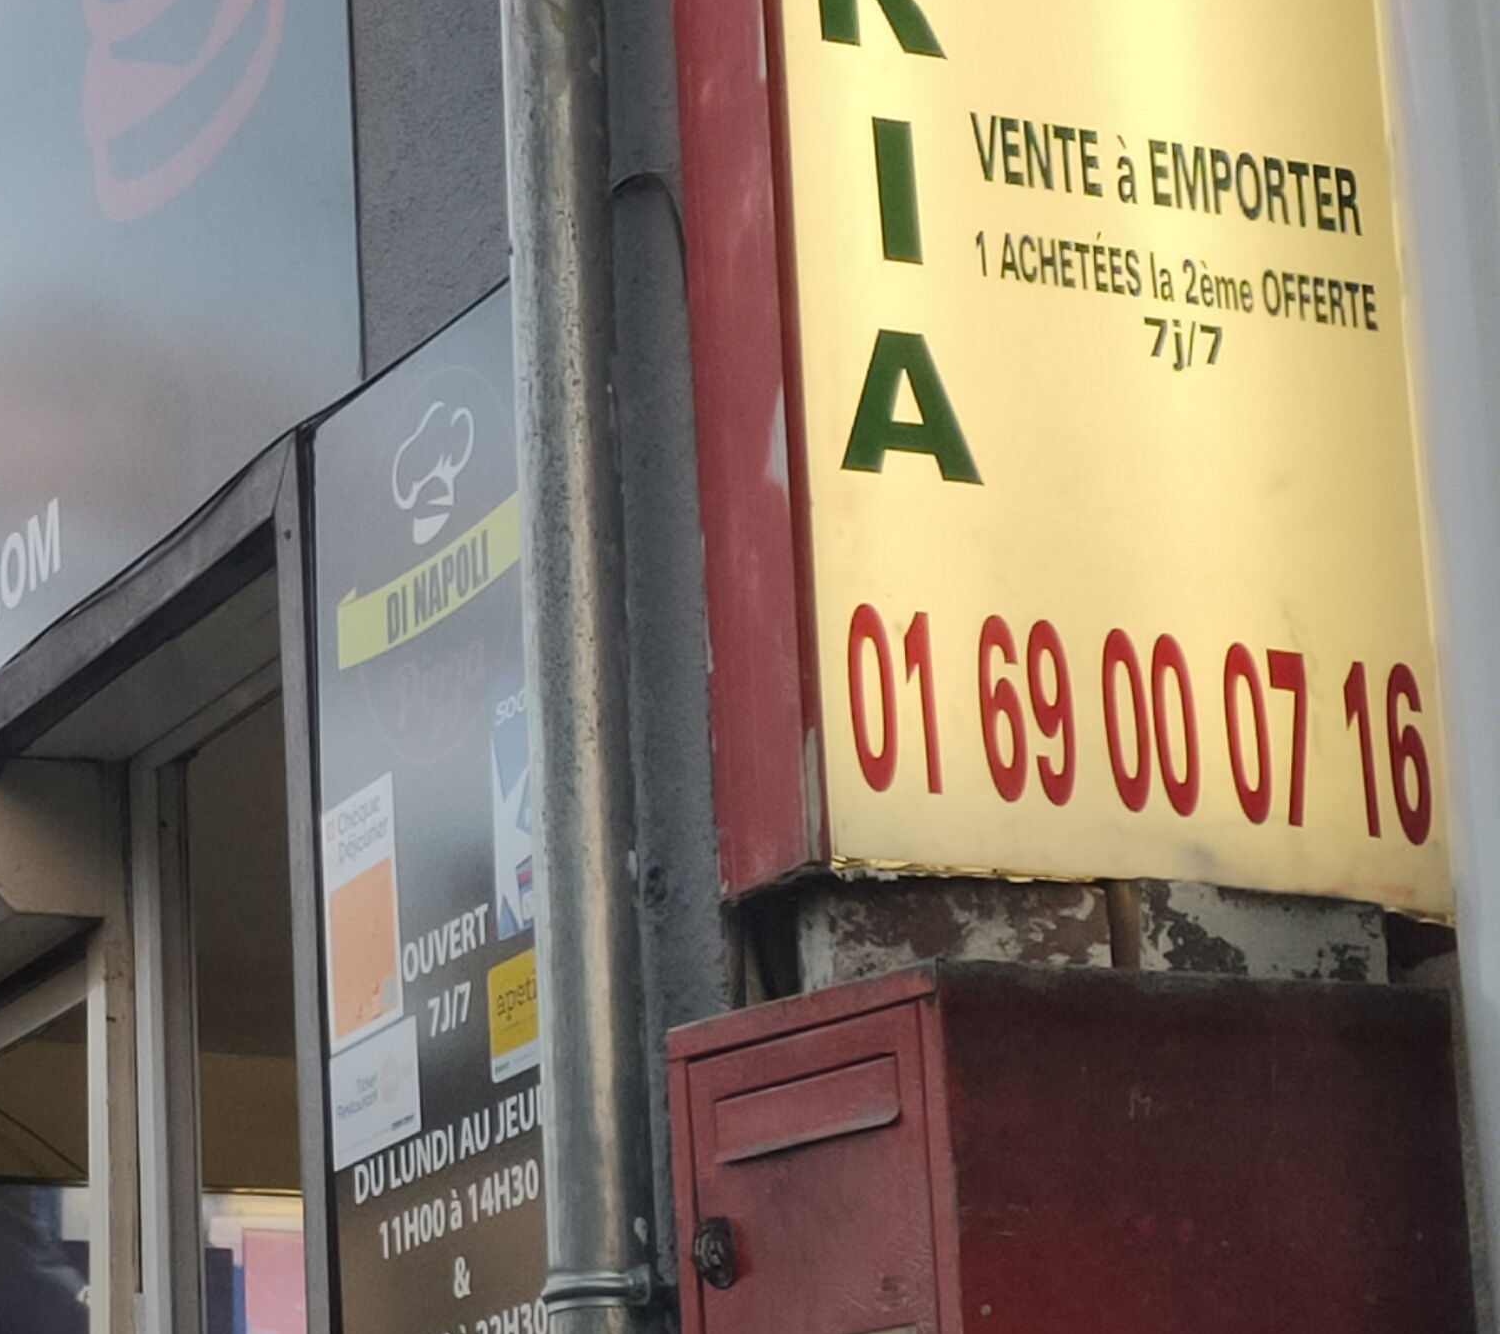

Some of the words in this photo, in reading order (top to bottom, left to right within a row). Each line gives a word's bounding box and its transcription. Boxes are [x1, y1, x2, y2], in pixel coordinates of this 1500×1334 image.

[970, 111, 1102, 198] VENTE
[1116, 135, 1139, 205] à
[1148, 138, 1363, 237] EMPORTER
[975, 231, 988, 279] 1
[1000, 232, 1142, 297] ACHETÉES
[1149, 250, 1175, 302] la
[1183, 258, 1255, 313] 2ème
[1262, 268, 1379, 332] OFFERTE
[1143, 317, 1224, 371] 7j/7
[386, 585, 409, 646] DI
[413, 528, 490, 627] NAPOLI
[847, 602, 943, 795] 01
[978, 614, 1076, 807] 69
[1101, 627, 1201, 818] 00
[1223, 641, 1306, 828] 07
[1344, 661, 1433, 847] 16
[402, 904, 489, 983] OUVERT
[427, 982, 472, 1037] 7J/7
[354, 1160, 385, 1206] DU
[388, 1127, 455, 1191] LUNDI
[459, 1109, 491, 1164] AU
[378, 1198, 446, 1259] 11H00
[449, 1188, 464, 1231] à
[467, 1159, 539, 1224] 14H30
[453, 1256, 472, 1300] &
